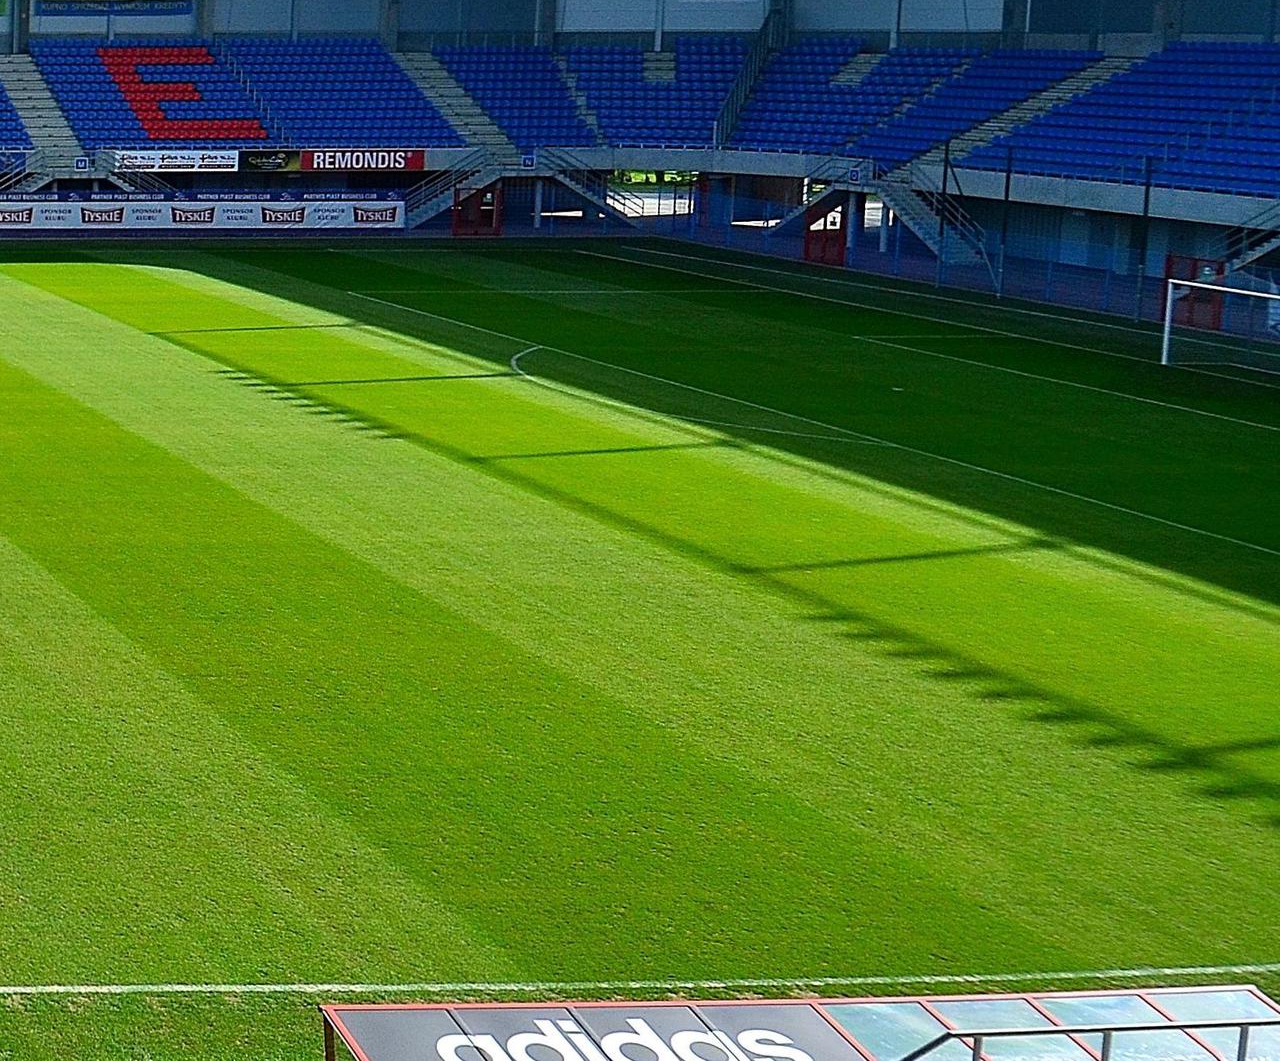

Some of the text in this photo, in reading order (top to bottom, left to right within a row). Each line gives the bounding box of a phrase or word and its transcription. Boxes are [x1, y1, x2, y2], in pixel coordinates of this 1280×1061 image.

[313, 152, 406, 169] REMONDIS
[84, 210, 121, 222] TYSKIE
[175, 210, 212, 222] TYSKIE
[265, 210, 303, 222] TYSKIE
[356, 209, 393, 221] TYSKIE
